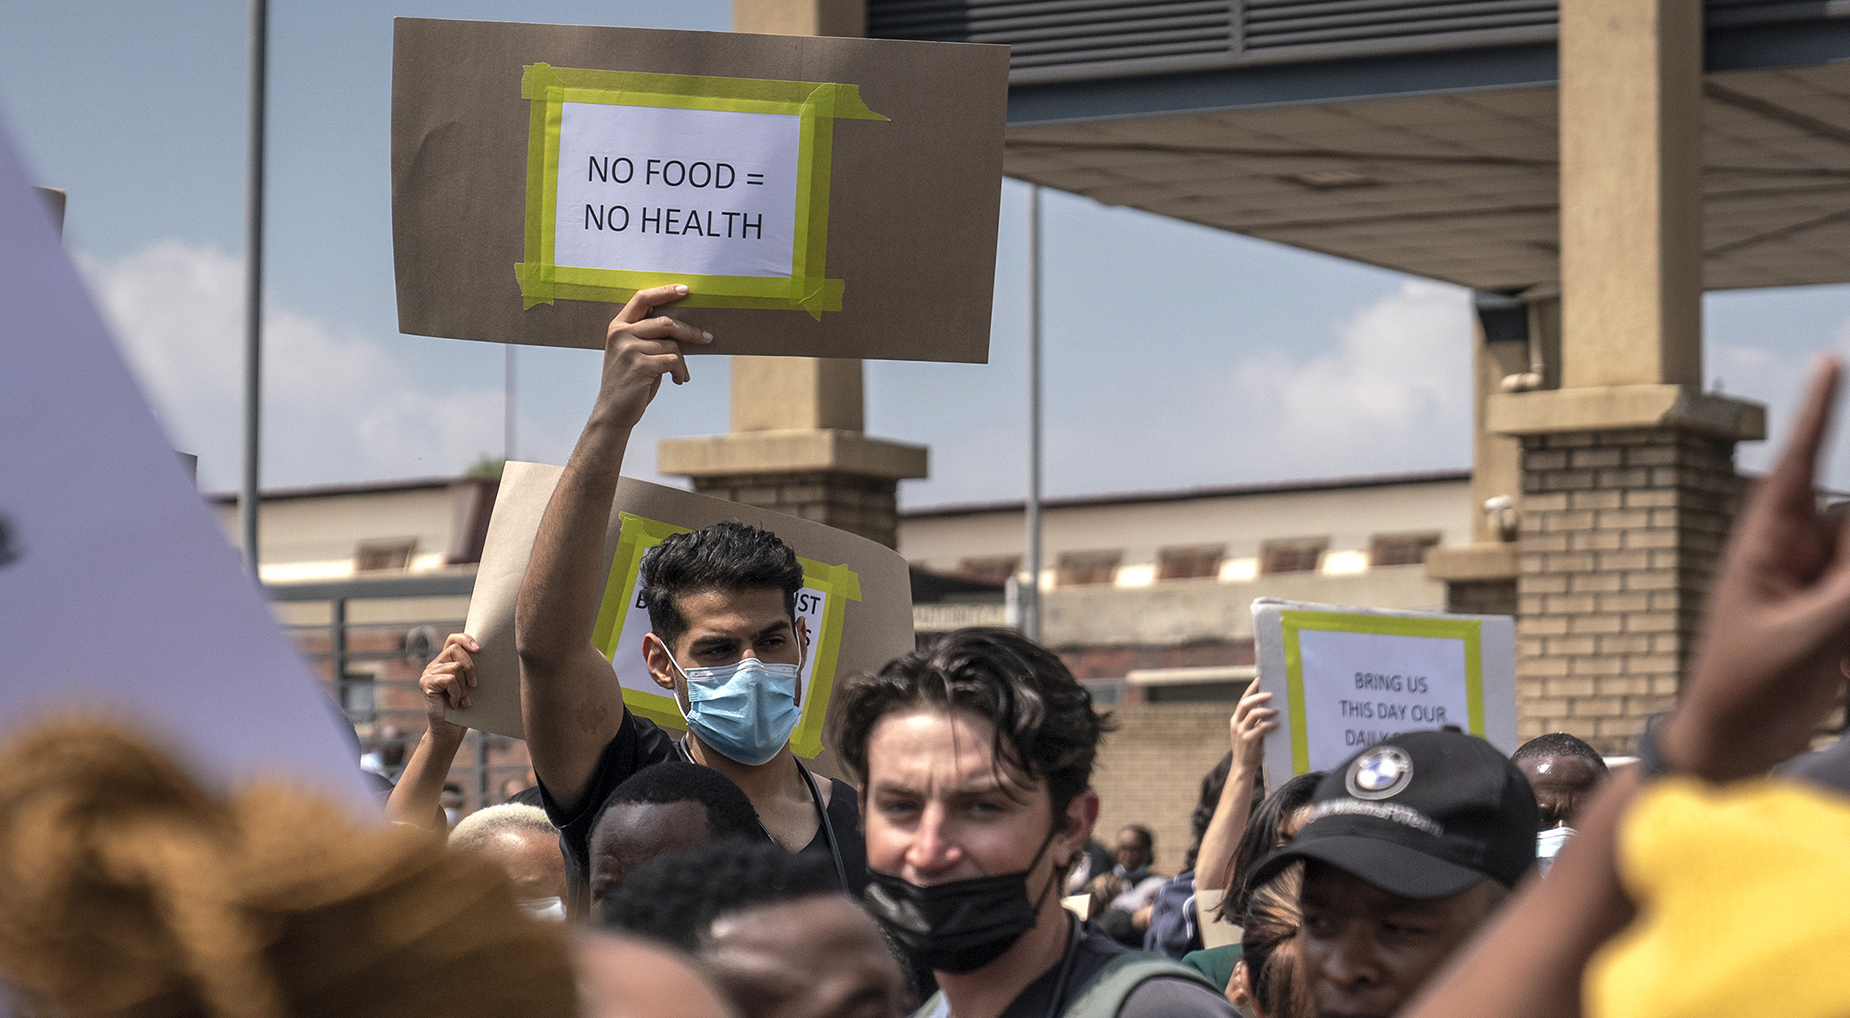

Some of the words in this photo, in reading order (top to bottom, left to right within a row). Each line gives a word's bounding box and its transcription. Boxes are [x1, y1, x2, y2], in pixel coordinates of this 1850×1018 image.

[588, 155, 634, 184] NO
[646, 159, 736, 189] FOOD
[746, 172, 764, 185] =
[584, 203, 630, 232] NO
[641, 206, 763, 240] HEALTH
[1355, 672, 1402, 692] BRING
[1407, 675, 1428, 694] US
[1339, 700, 1373, 719] THIS
[1377, 702, 1407, 721] DAY
[1411, 704, 1447, 723] OUR
